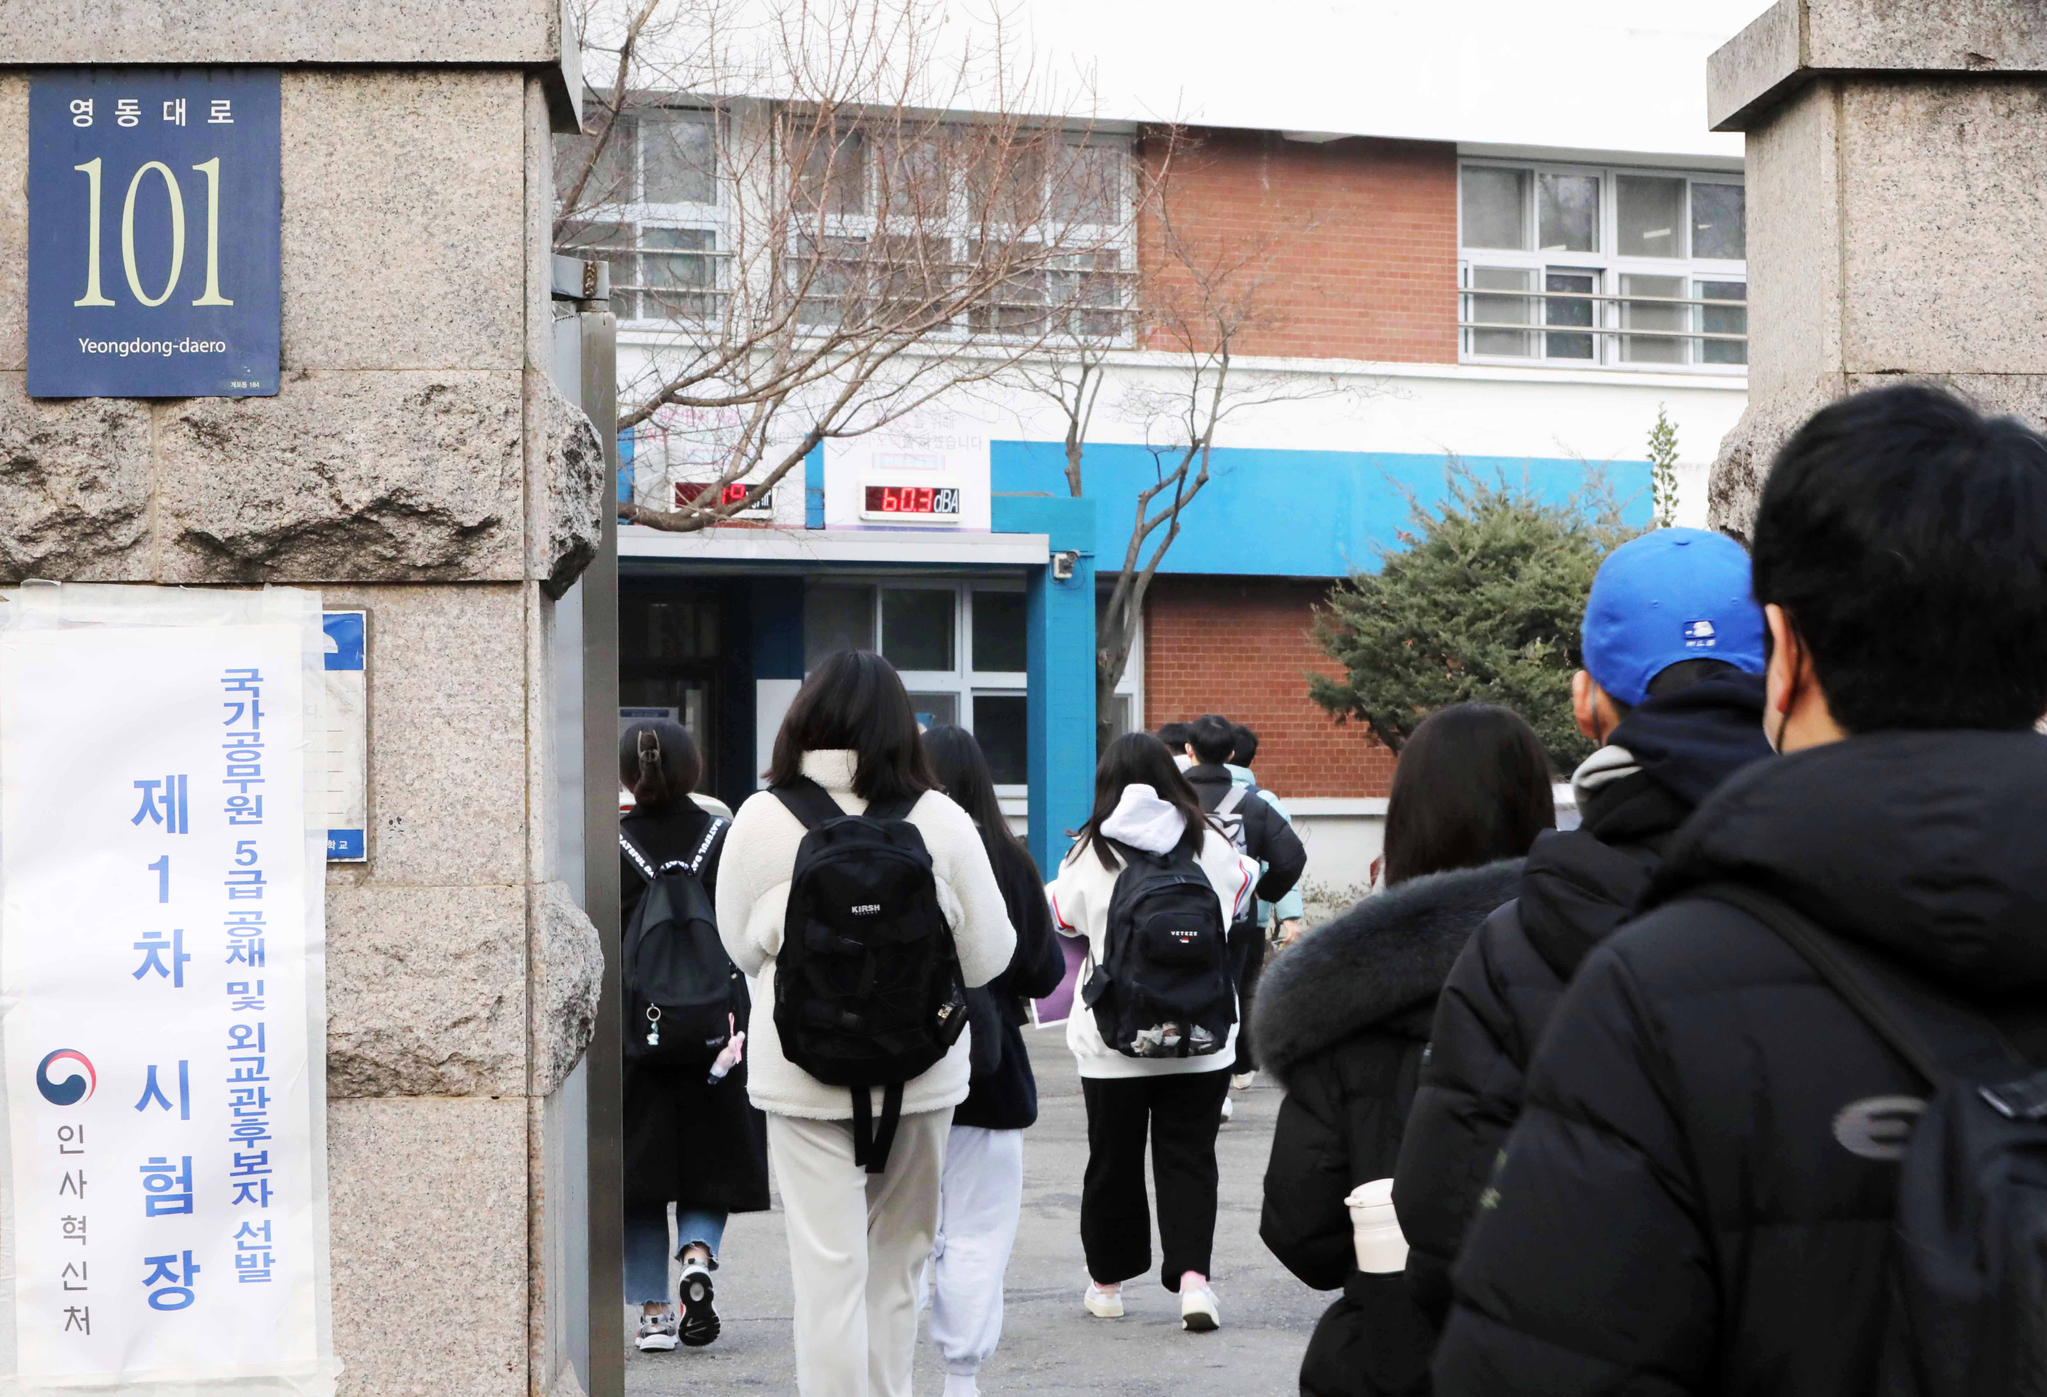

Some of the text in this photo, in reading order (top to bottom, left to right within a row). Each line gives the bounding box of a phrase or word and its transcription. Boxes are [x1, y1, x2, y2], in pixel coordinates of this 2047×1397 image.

[69, 98, 234, 127] 영동대로
[74, 157, 234, 307] 101
[78, 337, 226, 357] Yeongdong-daero
[933, 489, 959, 513] dBA
[851, 904, 880, 913] KIRSH
[220, 668, 276, 1284] 국가공무원 5급 공채 및 외교관후보자 선발
[57, 1124, 90, 1335] 인사혁신처
[134, 1060, 200, 1312] 시험장
